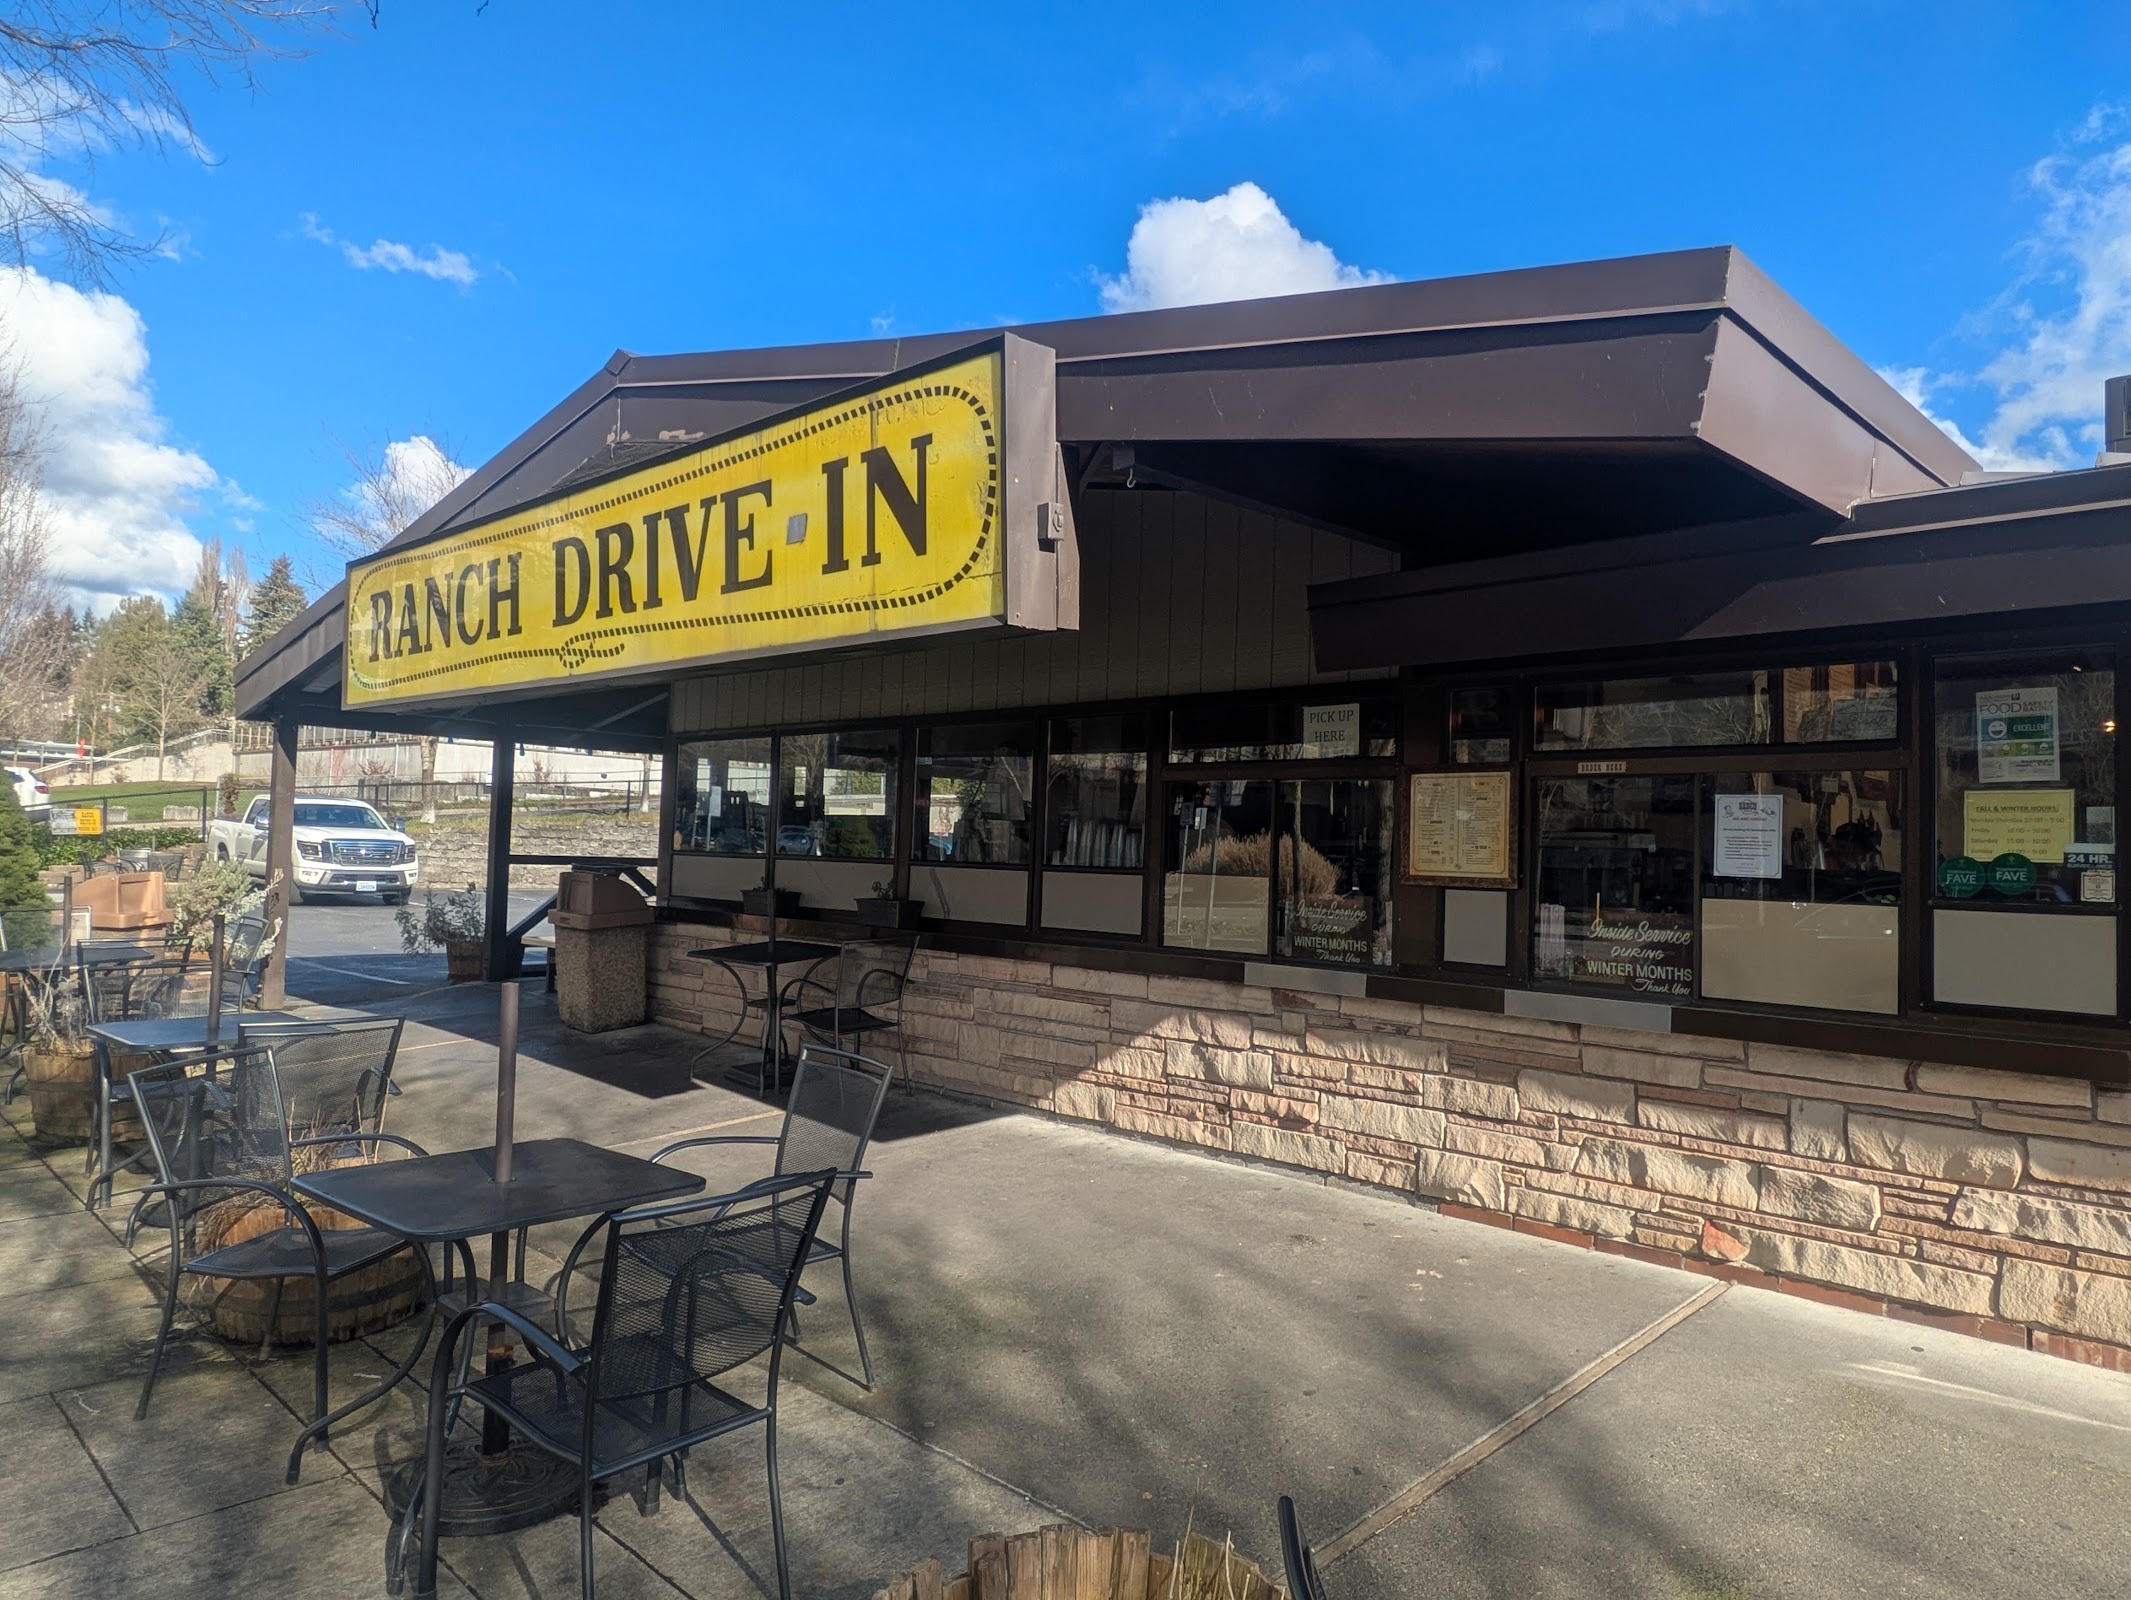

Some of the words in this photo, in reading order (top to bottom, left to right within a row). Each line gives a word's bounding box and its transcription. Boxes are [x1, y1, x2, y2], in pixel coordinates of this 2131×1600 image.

[369, 552, 522, 663] RANCH
[1980, 702, 2022, 715] FOOD
[1309, 711, 1336, 723] PICK
[1338, 710, 1354, 721] UP
[1314, 730, 1346, 742] HERE
[2067, 854, 2086, 863] 24
[1947, 873, 1977, 884] FAVE
[1996, 871, 2028, 881] FAVE
[1296, 900, 1327, 919] Inside
[1325, 901, 1368, 921] Service
[1587, 917, 1635, 941] Inside
[1634, 920, 1692, 945] Service
[1294, 936, 1328, 949] WINTER
[1328, 938, 1368, 953] MONTHS
[1316, 949, 1345, 962] Thank
[1610, 946, 1665, 960] DURING
[1587, 960, 1634, 977] WINTER
[1636, 964, 1693, 982] MONTHS
[1630, 978, 1671, 994] Thank
[1671, 982, 1691, 995] You
